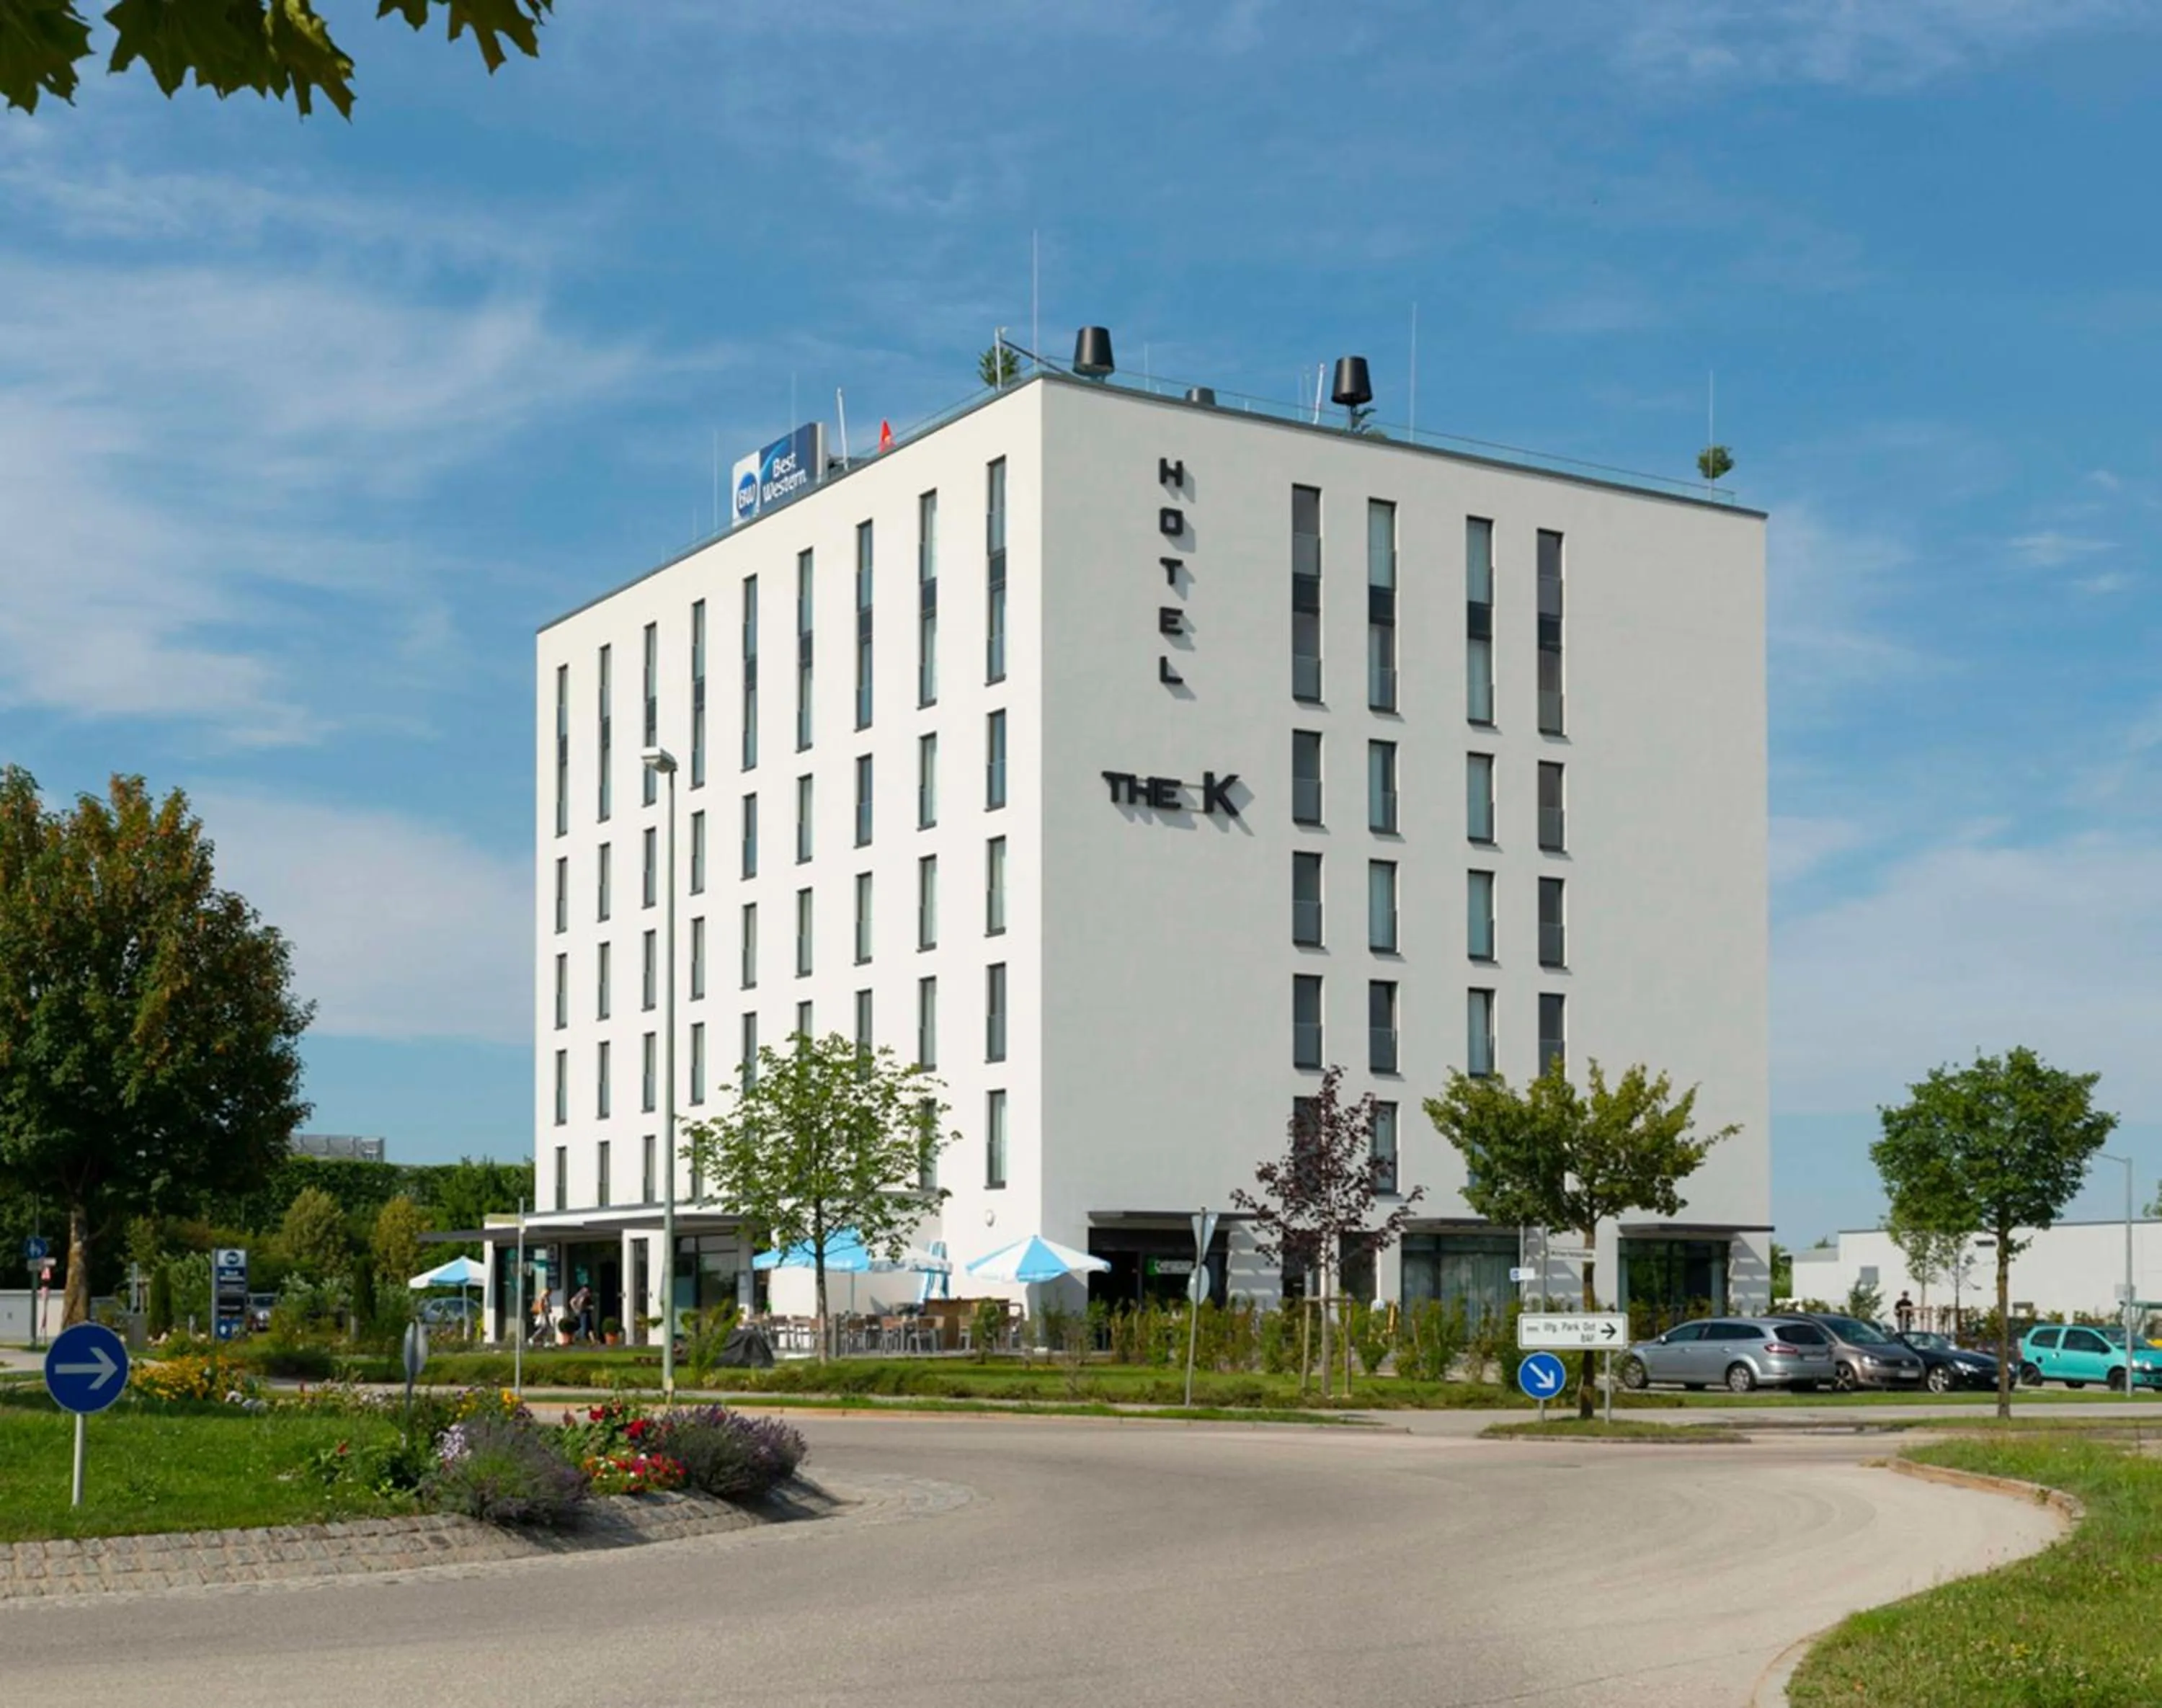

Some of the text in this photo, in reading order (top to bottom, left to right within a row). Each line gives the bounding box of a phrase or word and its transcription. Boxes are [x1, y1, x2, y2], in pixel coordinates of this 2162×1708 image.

[762, 468, 806, 503] Western
[773, 453, 796, 479] Best
[1159, 458, 1183, 684] HOTEL
[1101, 771, 1240, 817] THE K
